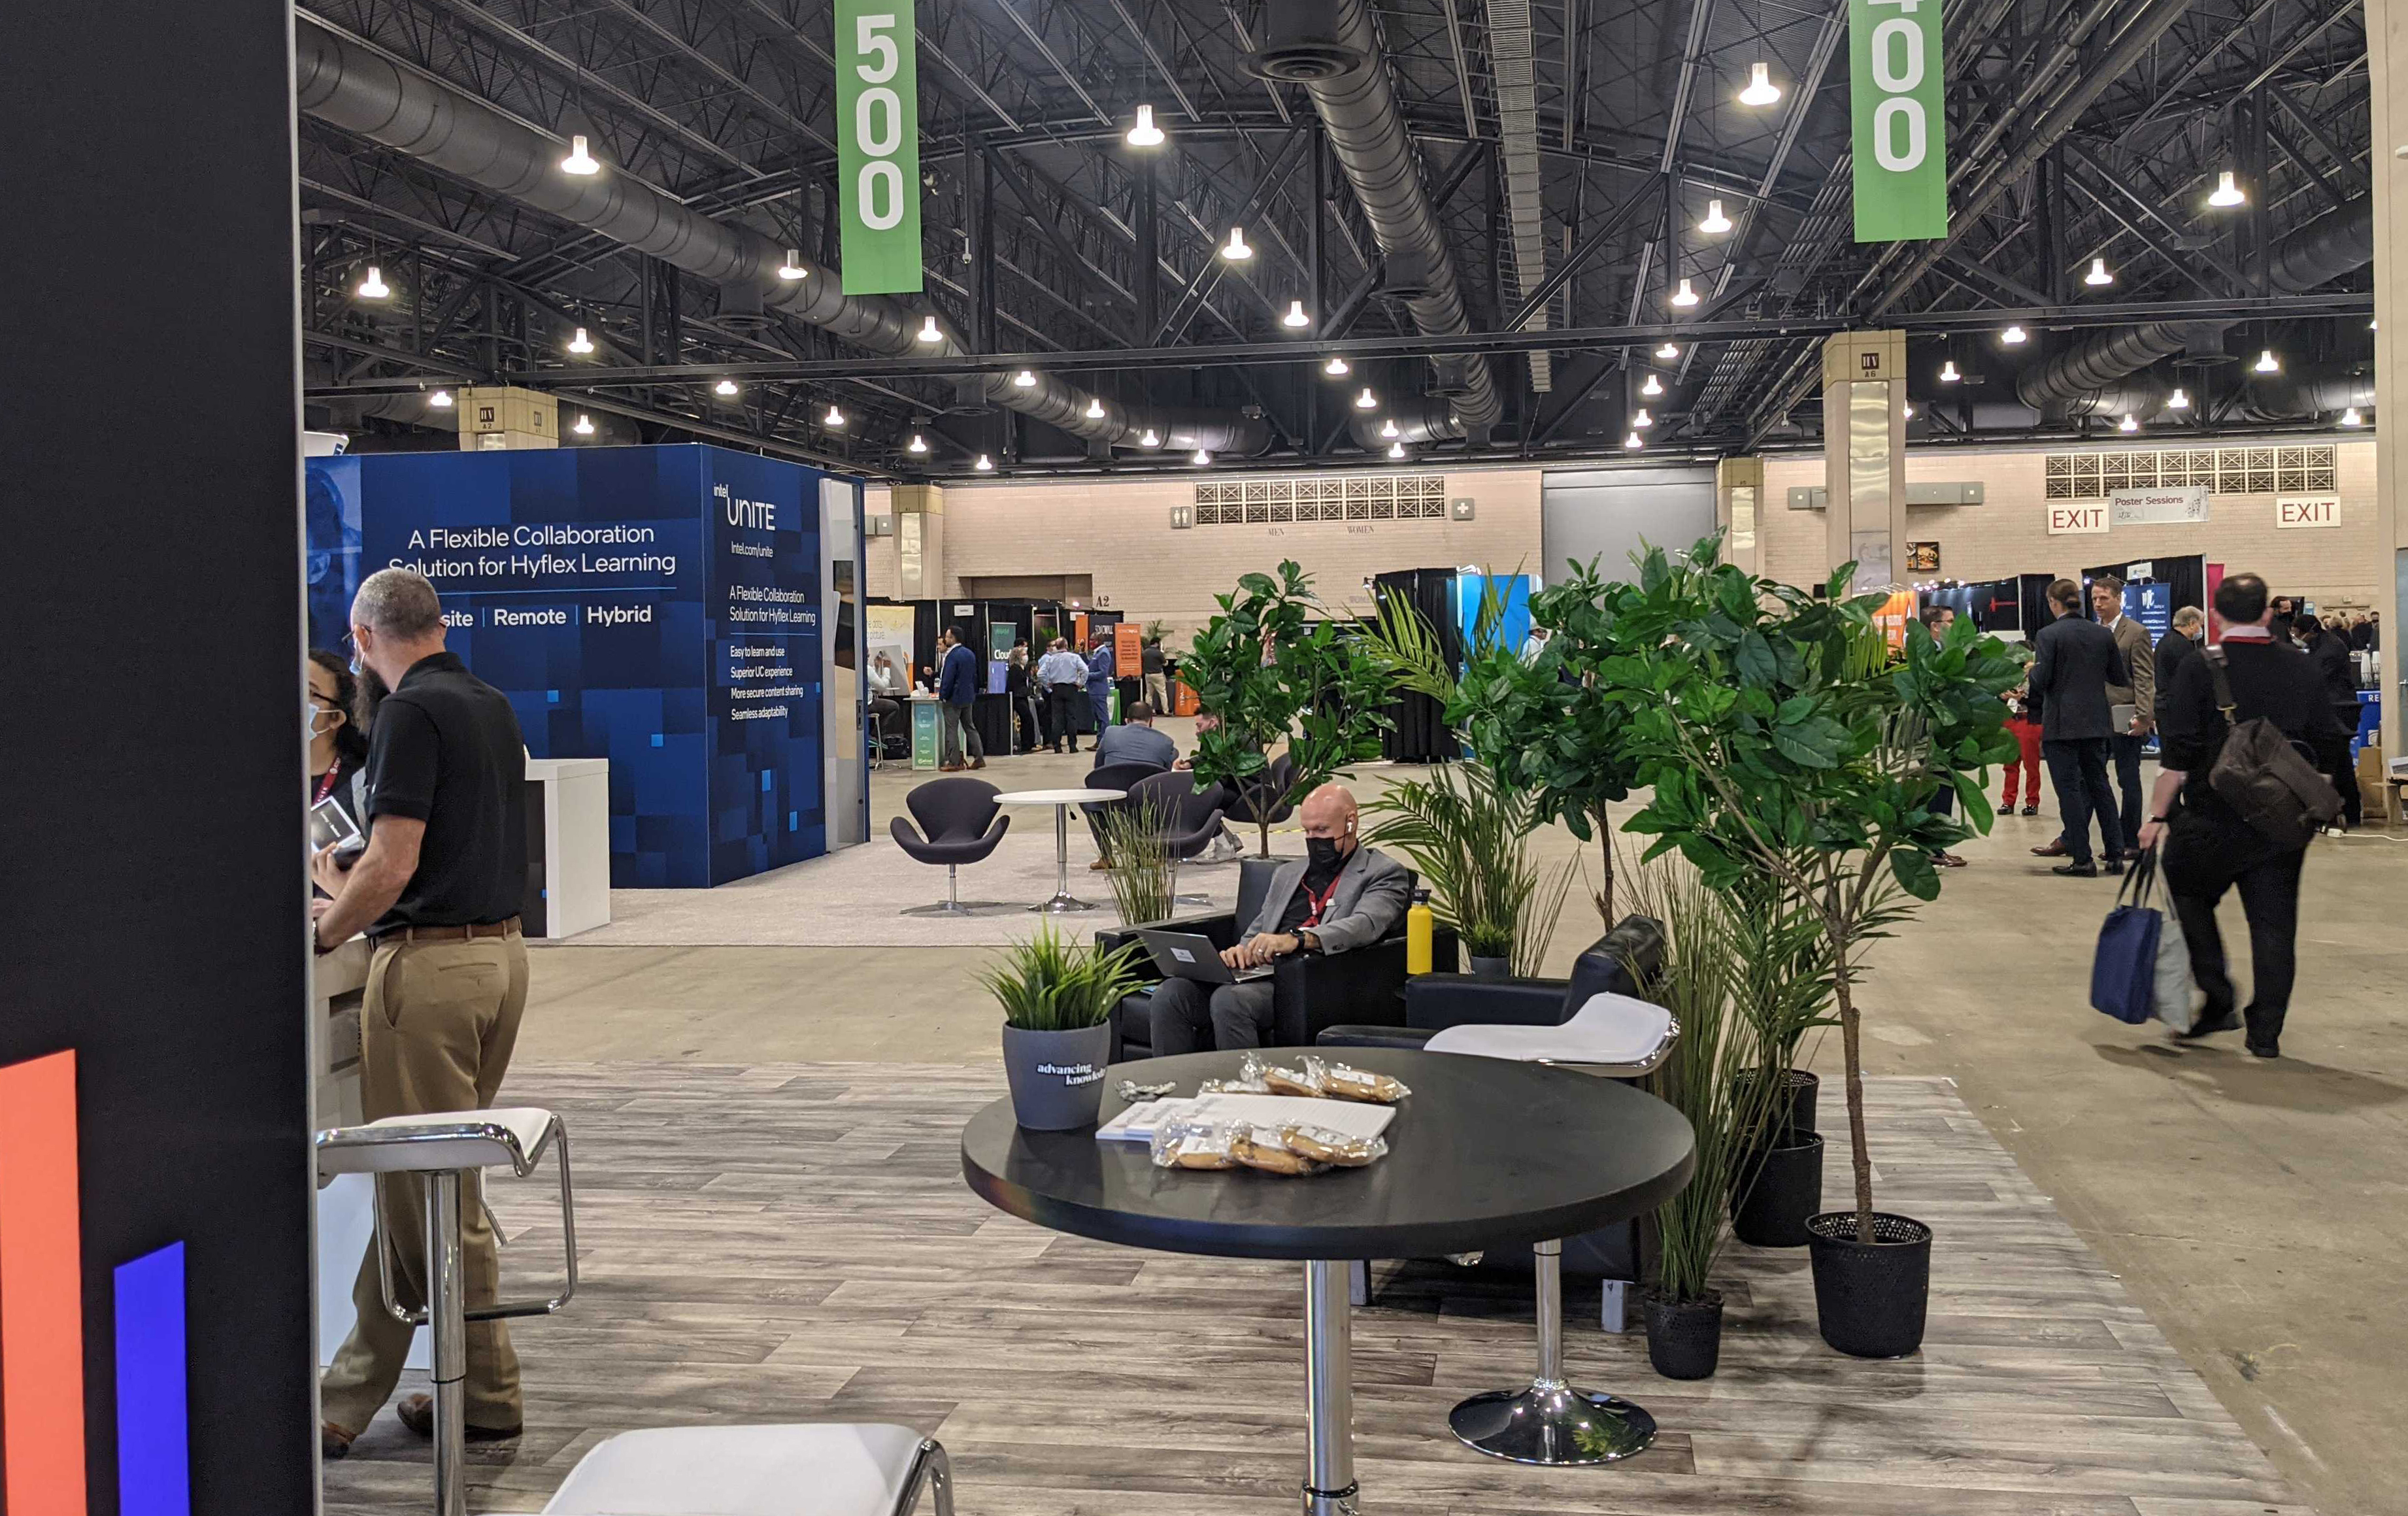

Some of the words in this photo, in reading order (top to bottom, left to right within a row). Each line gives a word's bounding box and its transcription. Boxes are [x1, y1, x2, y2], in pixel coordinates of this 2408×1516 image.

[1867, 0, 1926, 172] 00
[856, 14, 903, 231] 500
[714, 482, 729, 498] intel
[2115, 497, 2143, 506] Poster
[2145, 496, 2184, 505] Sessions
[2052, 509, 2103, 528] EXIT
[2282, 502, 2335, 522] EXIT
[407, 530, 426, 550] A
[429, 528, 509, 548] Flexible
[514, 525, 654, 547] Collaboration
[1268, 528, 1285, 537] MEN
[1346, 525, 1375, 534] WOMEN
[731, 541, 773, 558] Intel.com/unite
[478, 556, 506, 576] for
[511, 554, 577, 579] Hyflex
[581, 553, 677, 576] Learning
[729, 585, 737, 600] A
[737, 586, 763, 602] Flexible
[763, 587, 805, 603] Collaboration
[1096, 596, 1109, 607] A2
[493, 608, 567, 626] Remote
[587, 605, 652, 629] Hybrid
[730, 607, 758, 622] Solution
[759, 607, 769, 622] for
[769, 609, 790, 626] Hyflex
[790, 609, 816, 626] Learning
[730, 645, 744, 660] Easy
[744, 647, 751, 657] to
[751, 646, 765, 657] learn
[765, 646, 775, 657] and
[775, 647, 785, 657] use
[731, 666, 755, 681] Superior
[755, 665, 765, 677] UC
[765, 665, 793, 679] experience
[731, 687, 746, 699] More
[746, 688, 765, 699] secure
[765, 686, 784, 698] content
[785, 684, 803, 698] sharing
[731, 708, 758, 720] Seamless
[758, 705, 788, 719] adaptability
[1037, 1063, 1092, 1074] advancing
